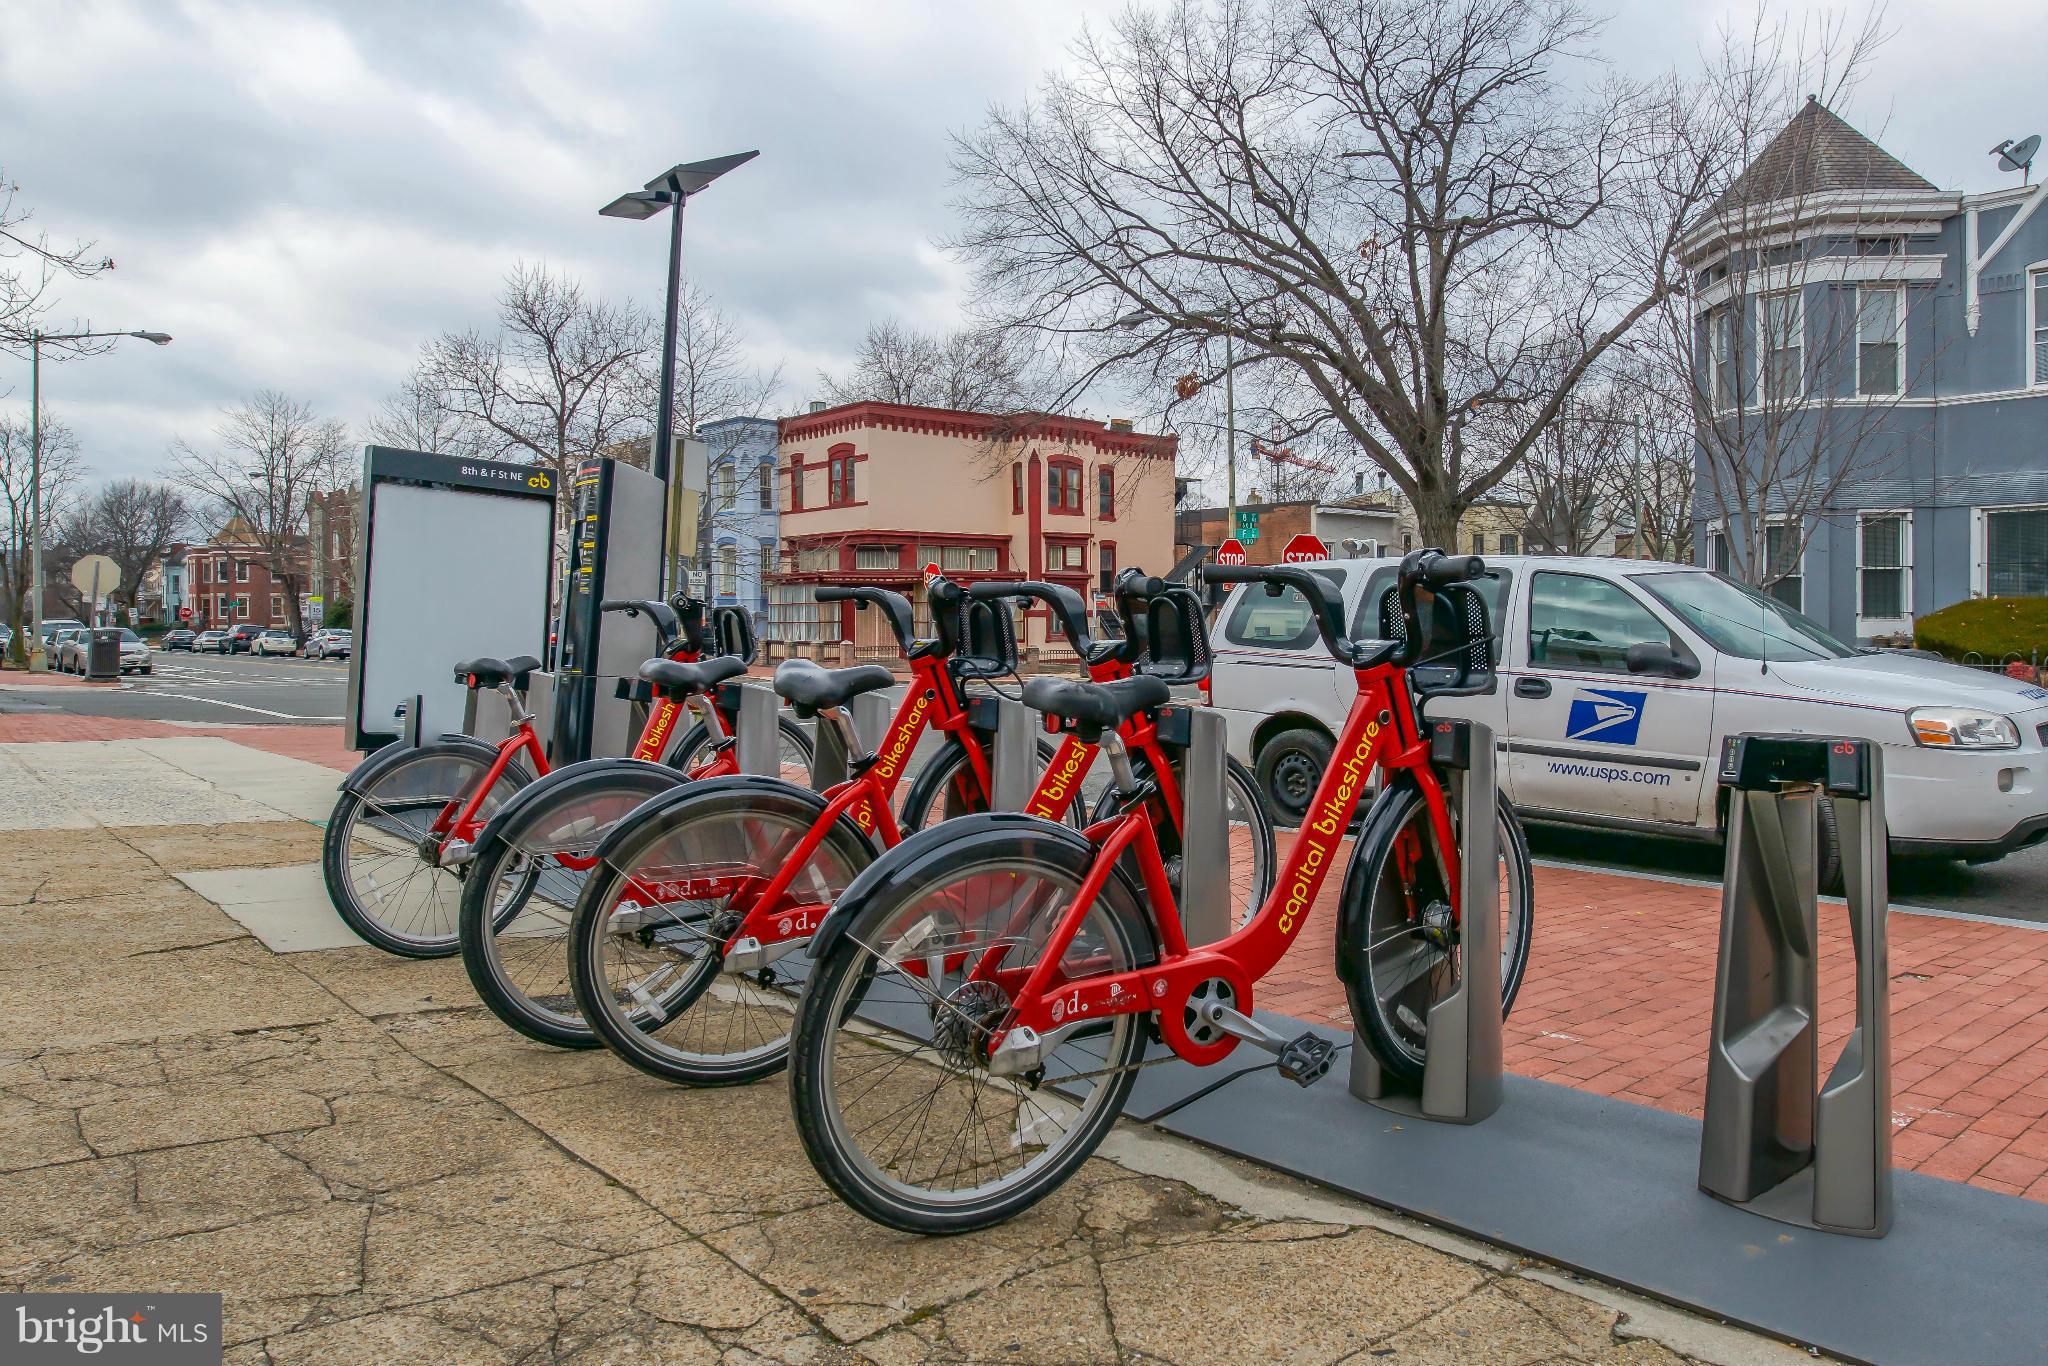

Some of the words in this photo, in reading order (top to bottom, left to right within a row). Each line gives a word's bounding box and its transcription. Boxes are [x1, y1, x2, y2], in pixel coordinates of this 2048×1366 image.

[461, 466, 478, 476] 8th
[480, 468, 488, 477] &
[490, 469, 497, 478] F
[498, 470, 508, 480] St
[510, 472, 523, 481] NE
[1219, 553, 1245, 565] STOP
[1286, 552, 1326, 563] STOP
[643, 703, 676, 747] bikesh
[874, 696, 928, 779] bikeshare
[1041, 740, 1088, 801] bikesh
[1548, 761, 1671, 786] www.usps.com
[1278, 839, 1326, 934] capital
[1311, 721, 1380, 836] bikeshare
